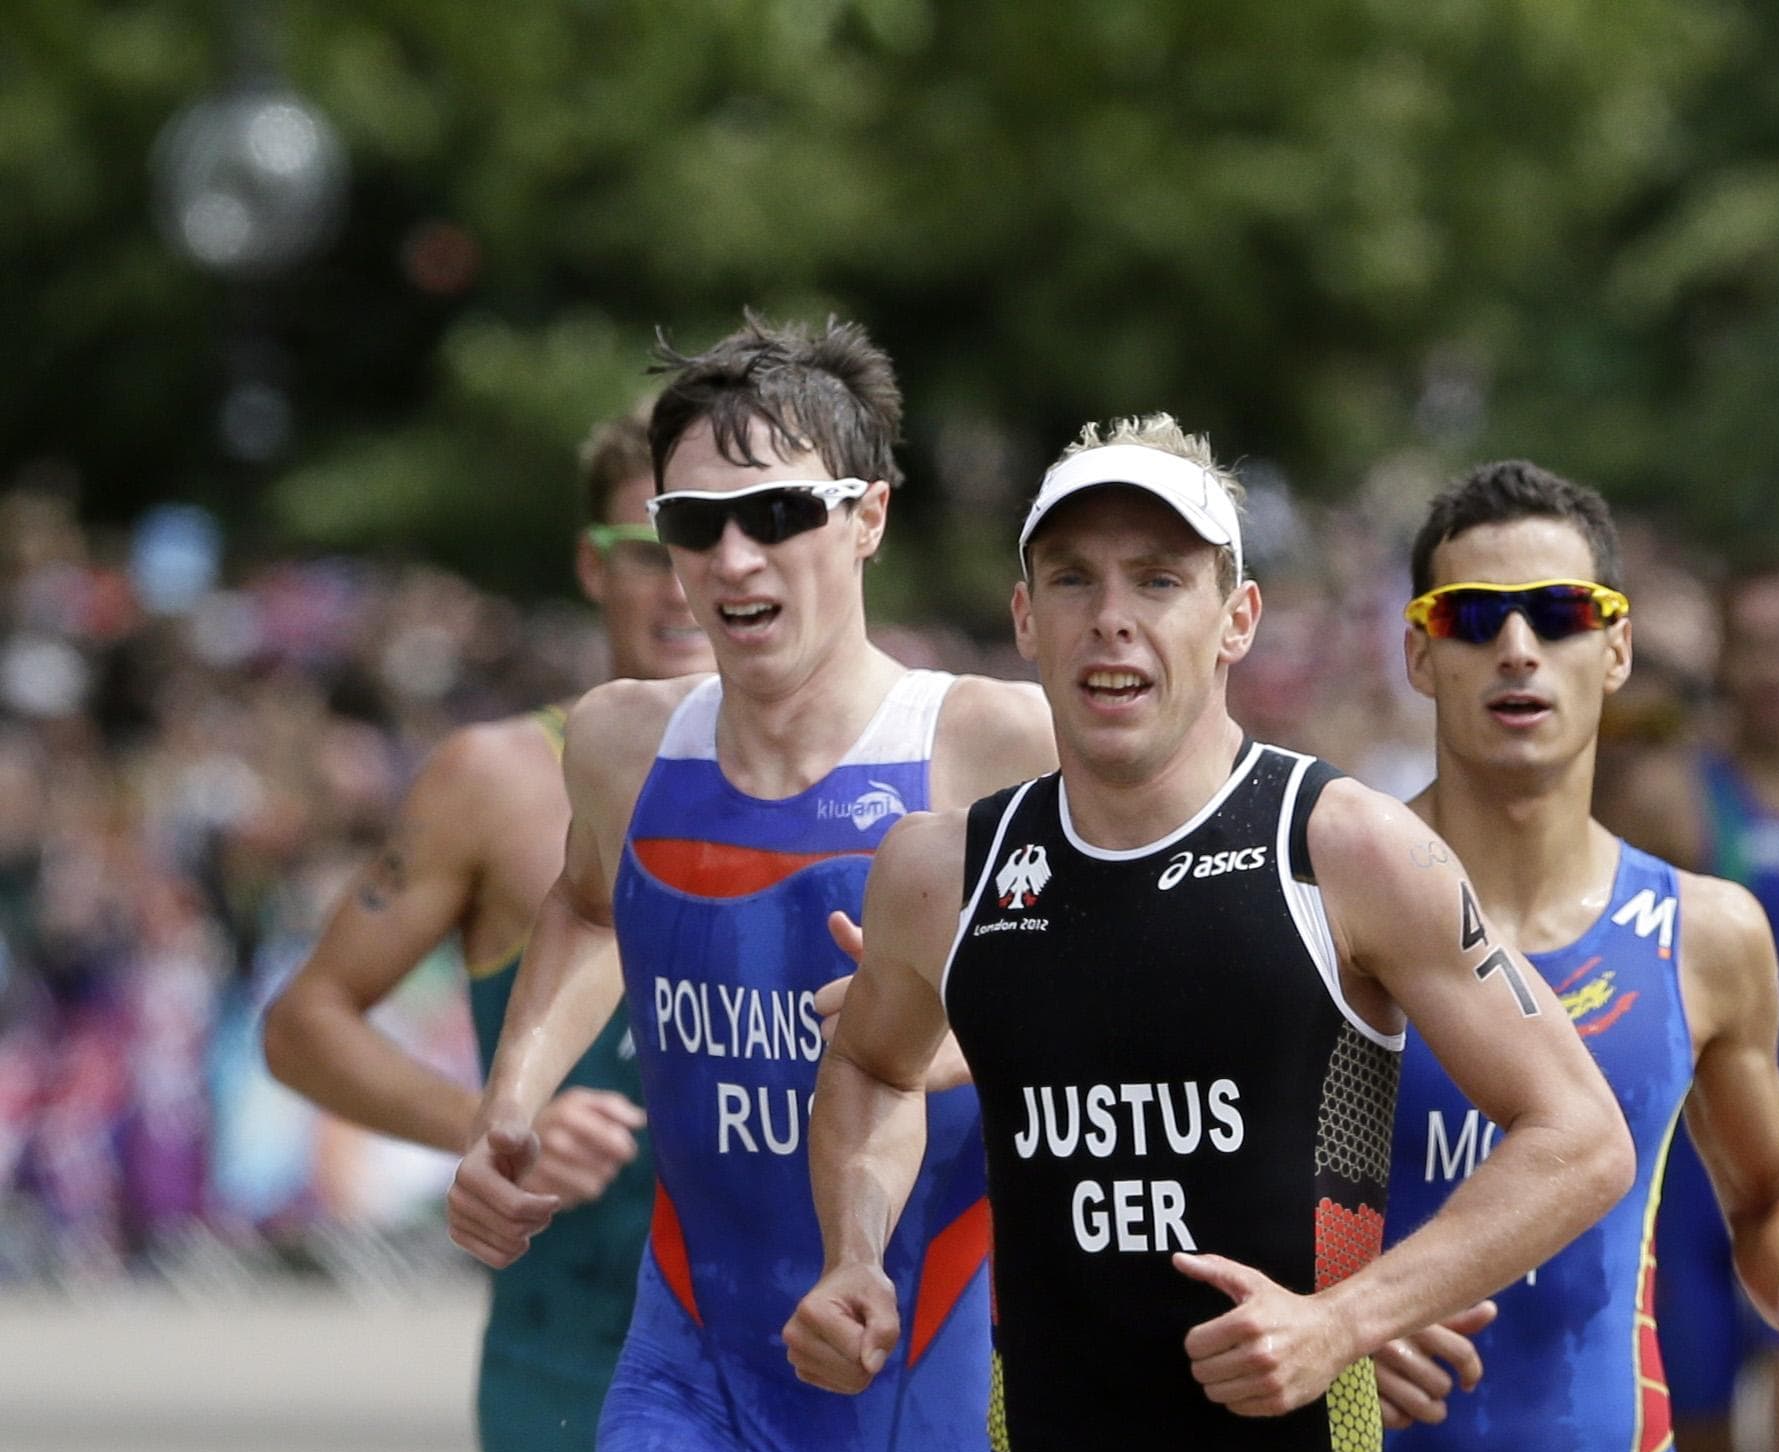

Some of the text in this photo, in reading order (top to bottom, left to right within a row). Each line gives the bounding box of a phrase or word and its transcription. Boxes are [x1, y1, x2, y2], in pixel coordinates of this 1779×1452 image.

[816, 797, 892, 820] kiwami
[1193, 846, 1268, 878] asics
[973, 917, 1049, 937] London 2012
[654, 975, 829, 1063] POLYANS
[717, 1082, 815, 1156] RU
[1014, 1078, 1245, 1159] JUSTUS
[1072, 1179, 1198, 1253] GER
